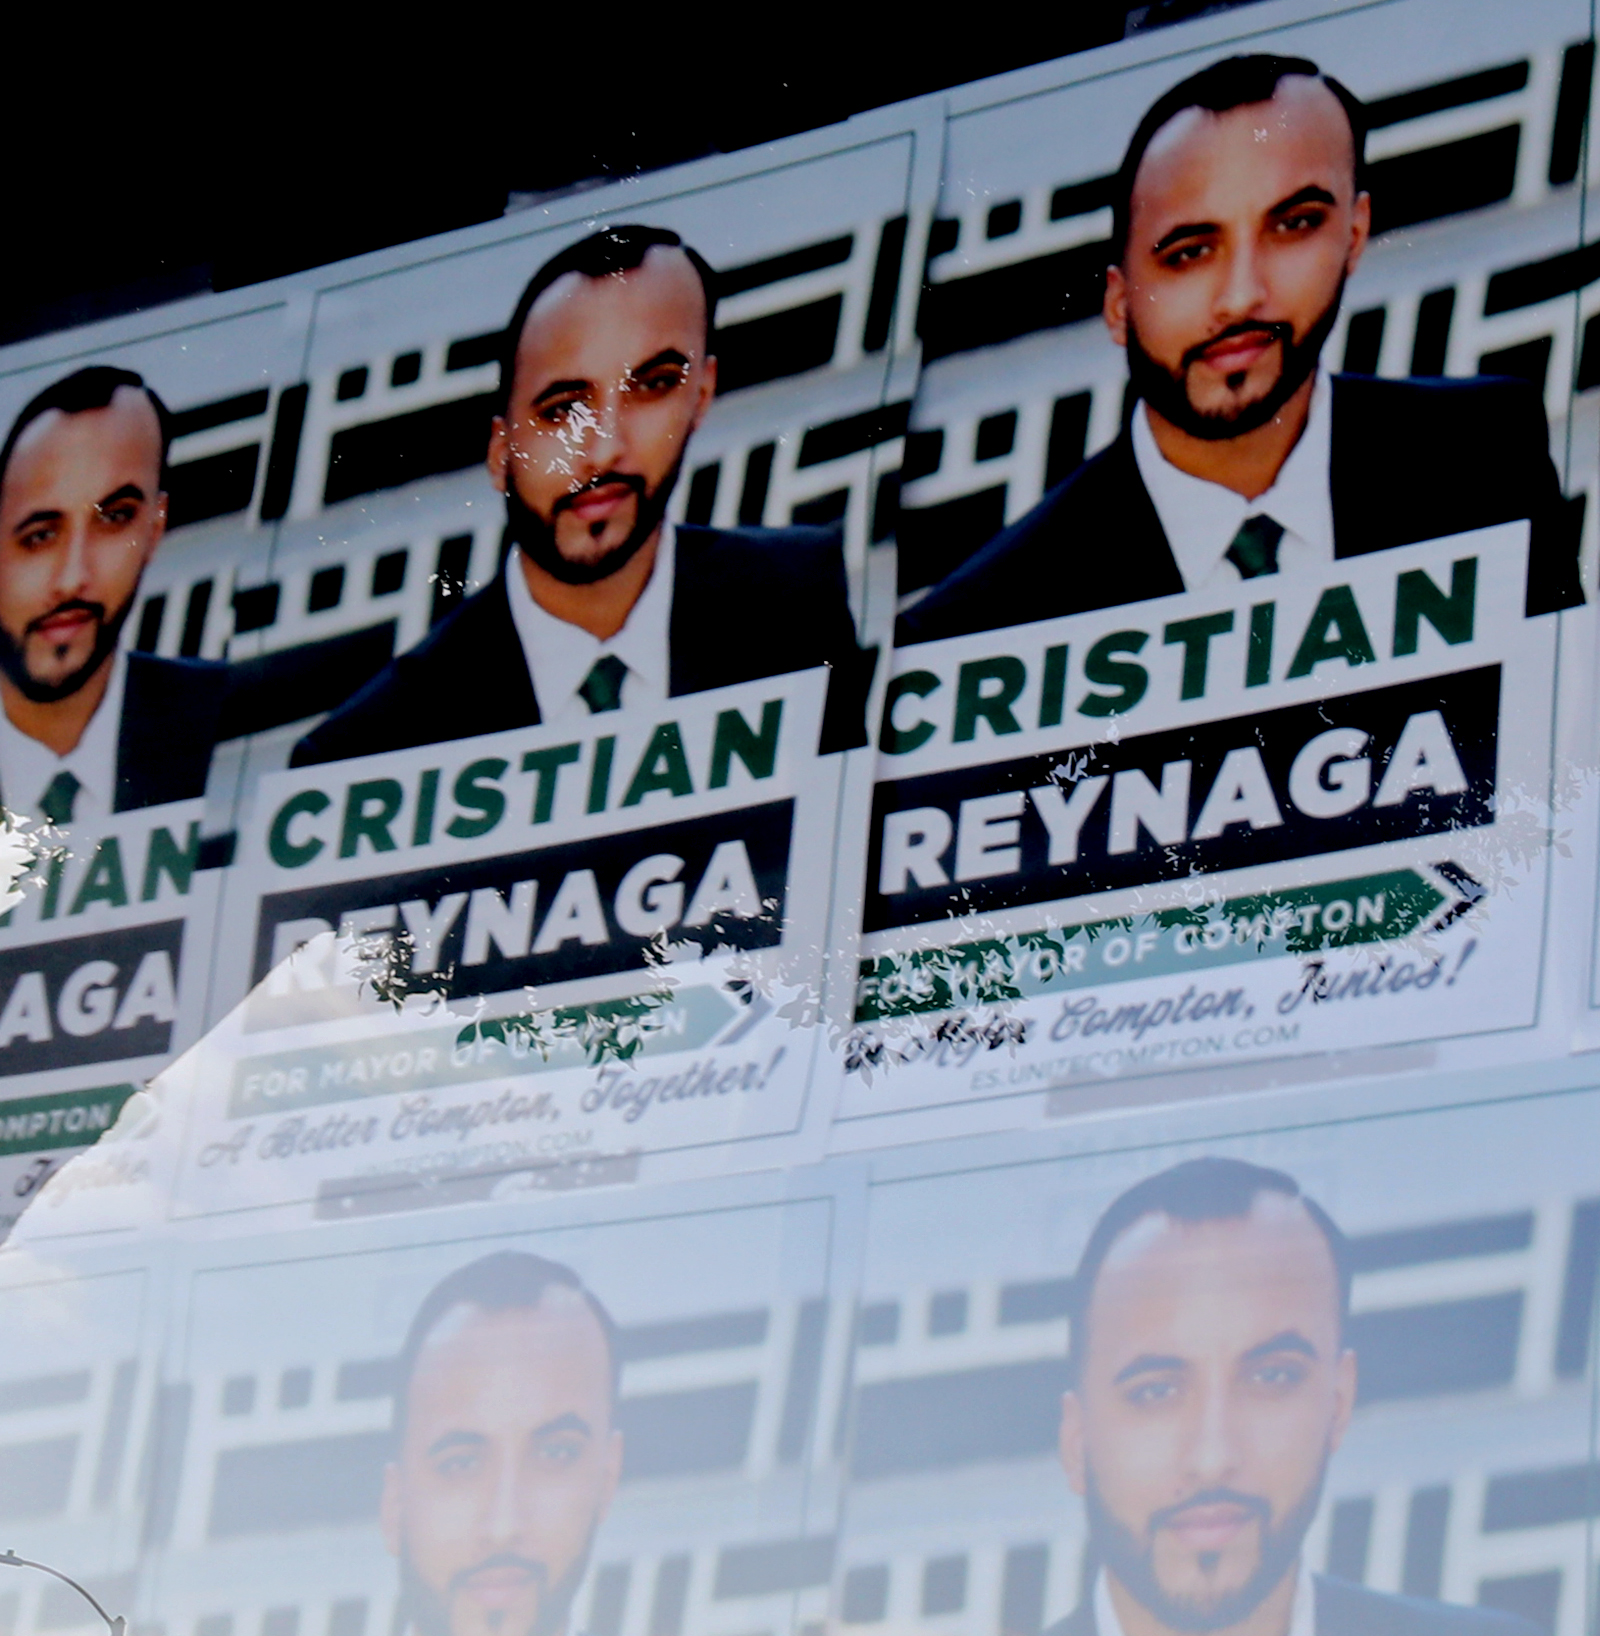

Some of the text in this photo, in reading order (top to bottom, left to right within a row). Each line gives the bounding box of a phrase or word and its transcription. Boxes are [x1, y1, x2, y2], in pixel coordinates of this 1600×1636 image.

[879, 556, 1479, 755] CRISTIAN
[267, 698, 785, 870] CRISTIAN
[879, 709, 1469, 895] REYNAGA
[270, 839, 763, 997] REYNAGA
[1102, 931, 1160, 967] OF
[240, 1040, 500, 1102] FOR MAYOR OF
[1049, 984, 1256, 1040] Compton,
[0, 1103, 112, 1142] MPTON
[200, 1045, 788, 1167] A Better Compton, Together!
